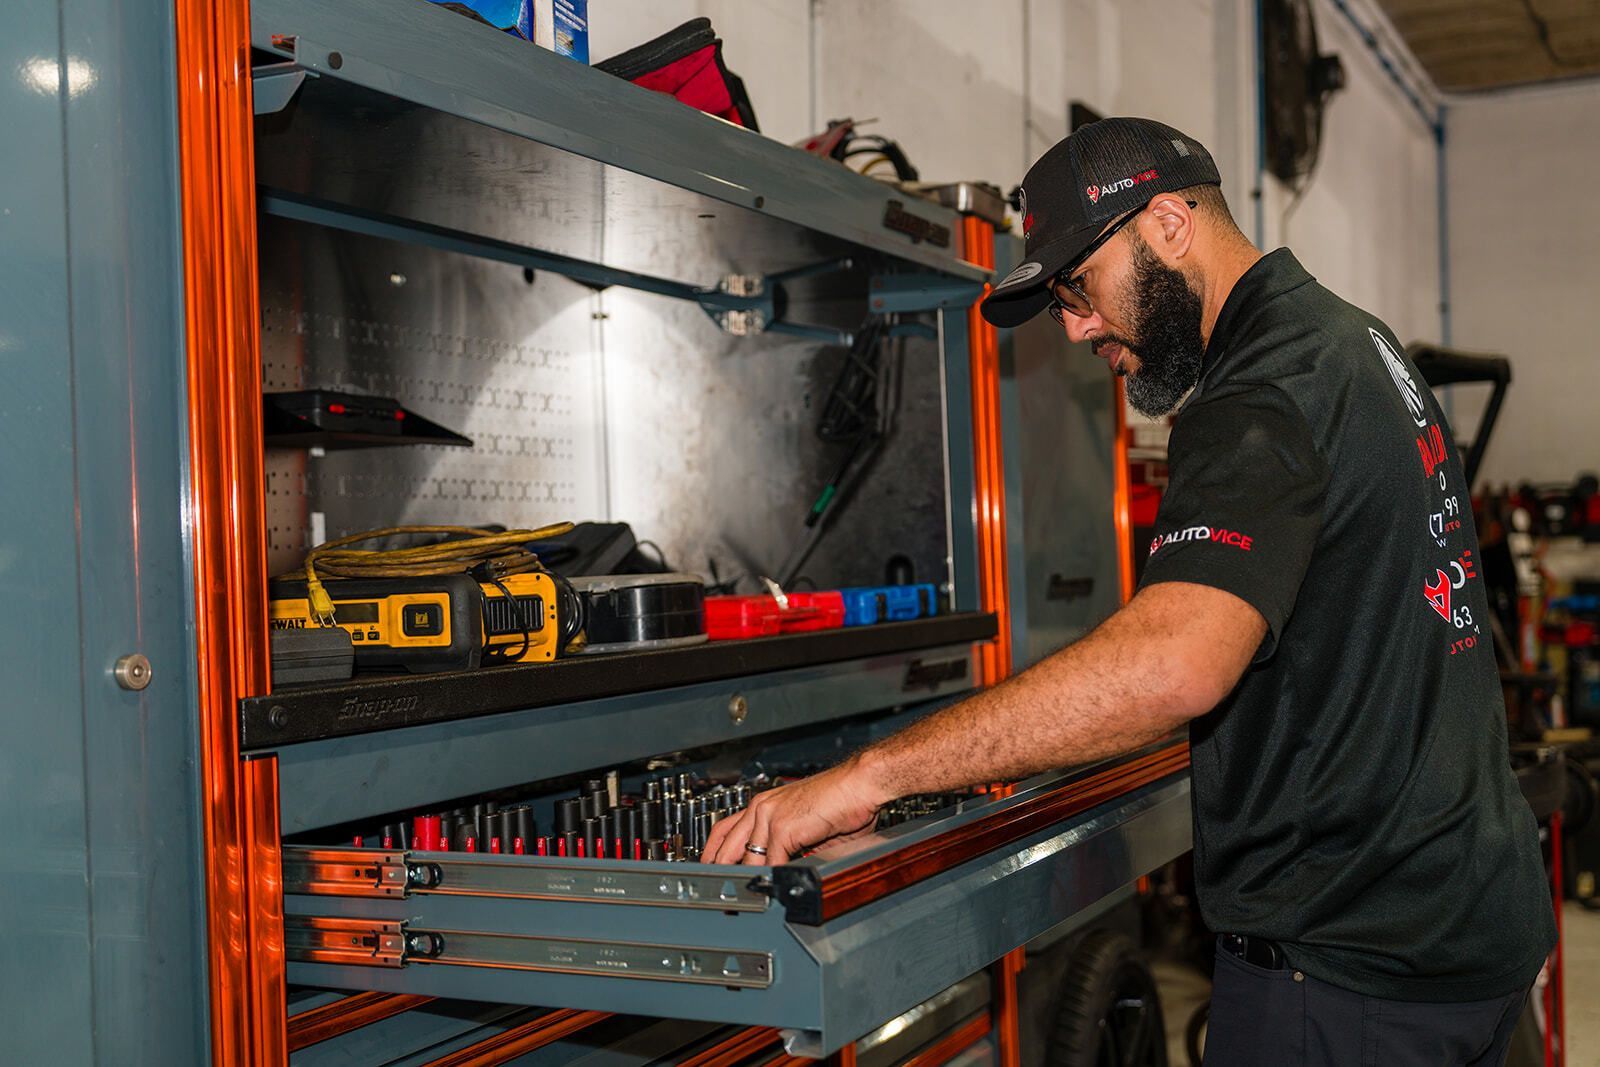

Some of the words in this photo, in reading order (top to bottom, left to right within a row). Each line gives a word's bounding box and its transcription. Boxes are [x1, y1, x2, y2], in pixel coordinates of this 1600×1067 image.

[1101, 169, 1160, 197] AUTOVICE
[1162, 526, 1253, 551] AUTOVICE
[1453, 605, 1473, 629] 63
